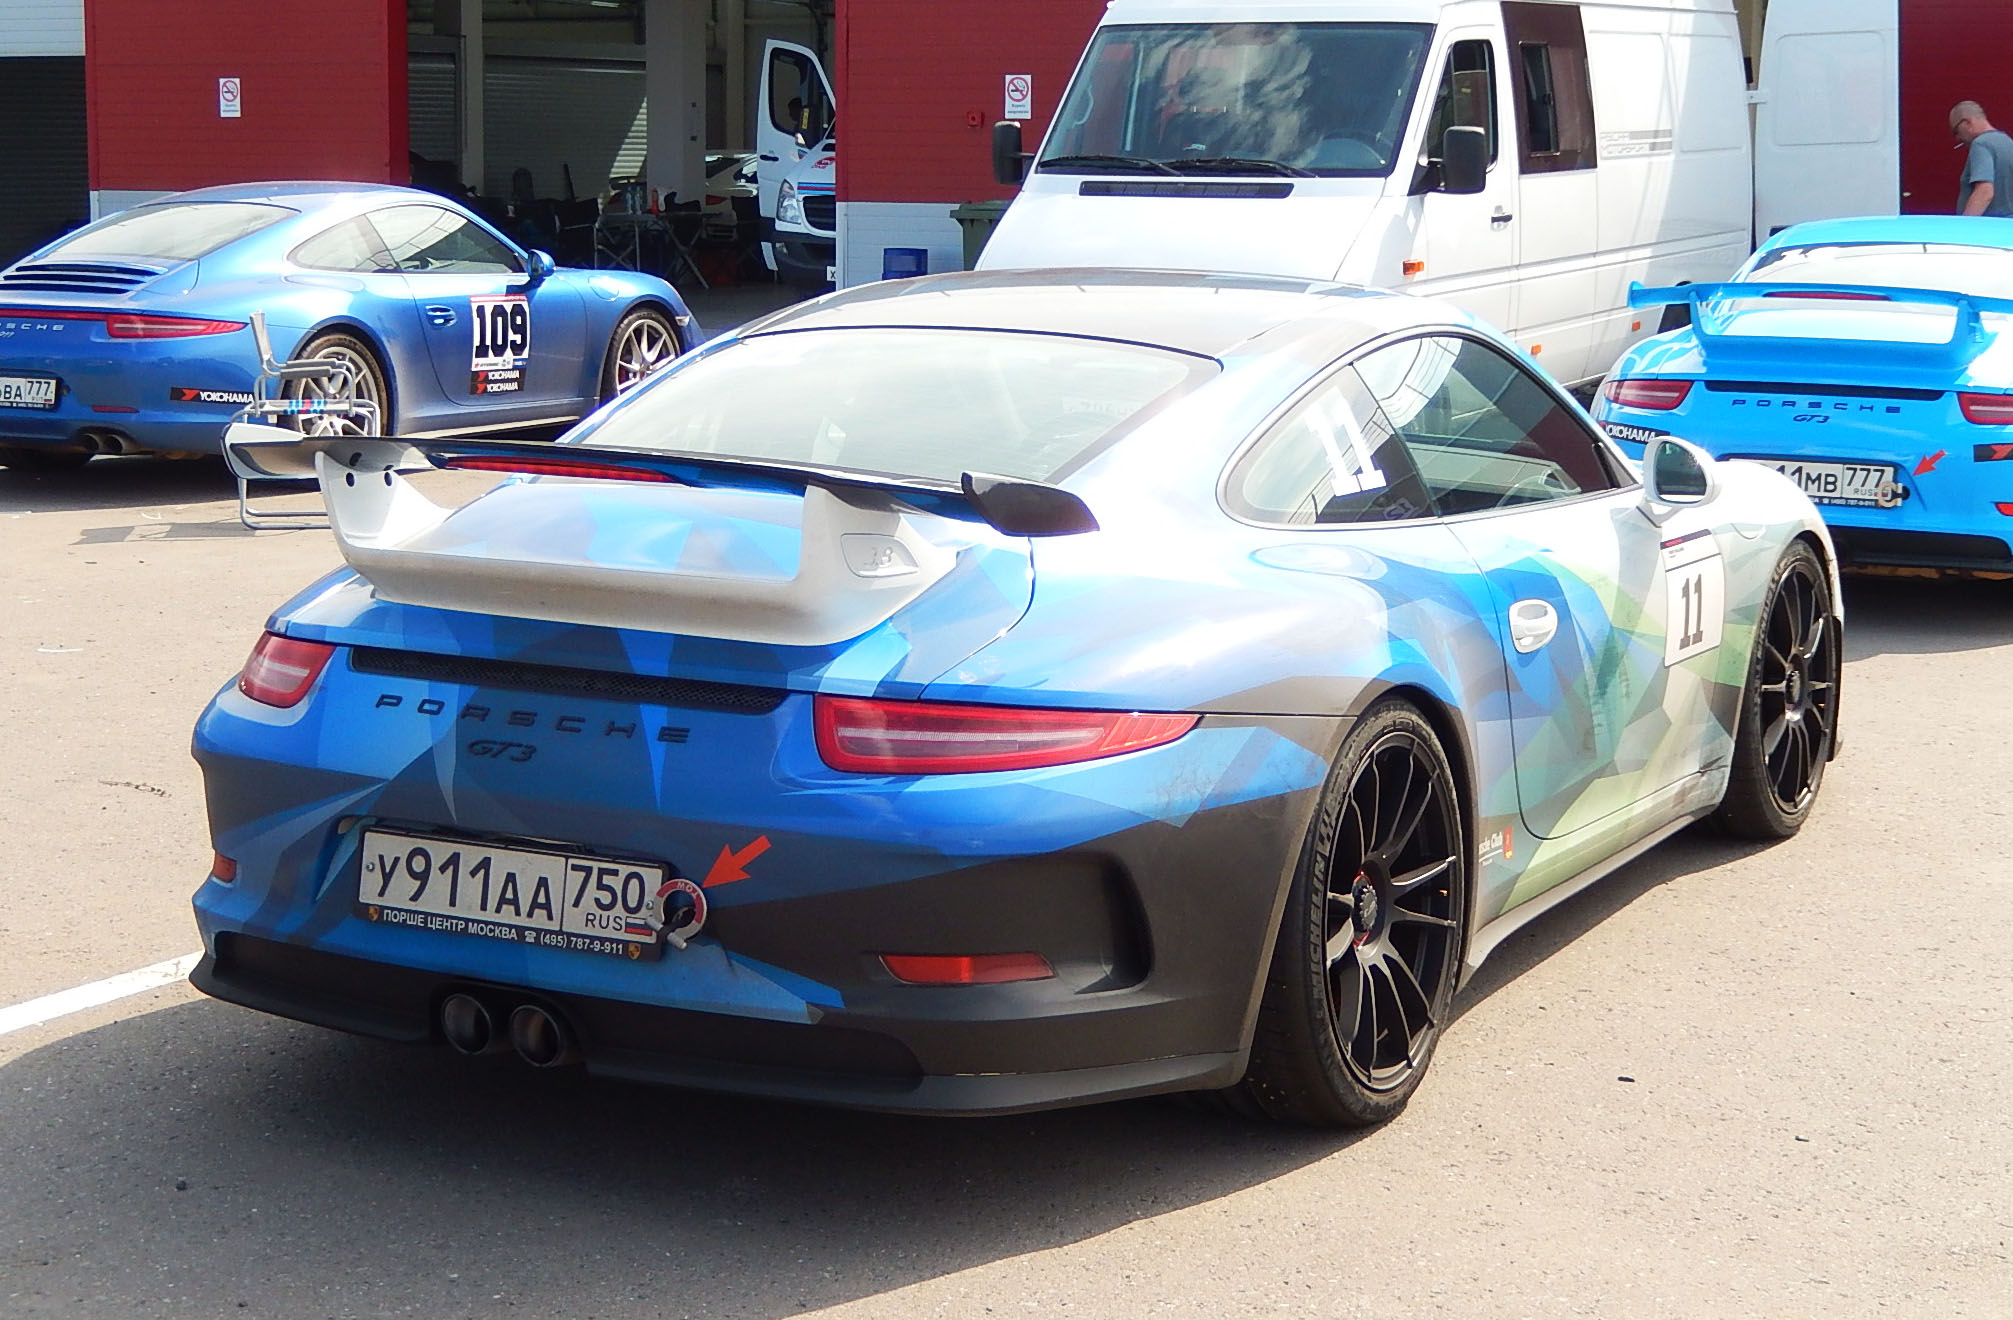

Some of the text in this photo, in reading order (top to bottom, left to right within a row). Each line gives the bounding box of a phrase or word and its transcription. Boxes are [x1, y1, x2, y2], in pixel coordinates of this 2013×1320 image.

[0, 322, 65, 331] SCHE
[475, 303, 528, 358] 109
[488, 370, 520, 381] YOKOHAMA
[27, 380, 51, 397] 777
[200, 390, 254, 404] YOKOHAMA
[486, 381, 519, 393] YOKOHAMA
[1731, 399, 1901, 414] PORSCHE
[1792, 414, 1830, 424] GT3
[1303, 386, 1388, 498] 11
[1845, 466, 1886, 489] 777
[1853, 487, 1874, 497] RUS
[1678, 573, 1704, 651] 11
[375, 693, 691, 744] PORSCHE
[467, 739, 537, 763] GT3
[570, 863, 646, 915] 750
[383, 909, 623, 955] ПОРШЕ ЦЕНТР МОСКВА (495) 787-9-911
[585, 911, 623, 932] RUS
[1309, 853, 1327, 999] MICHELIN
